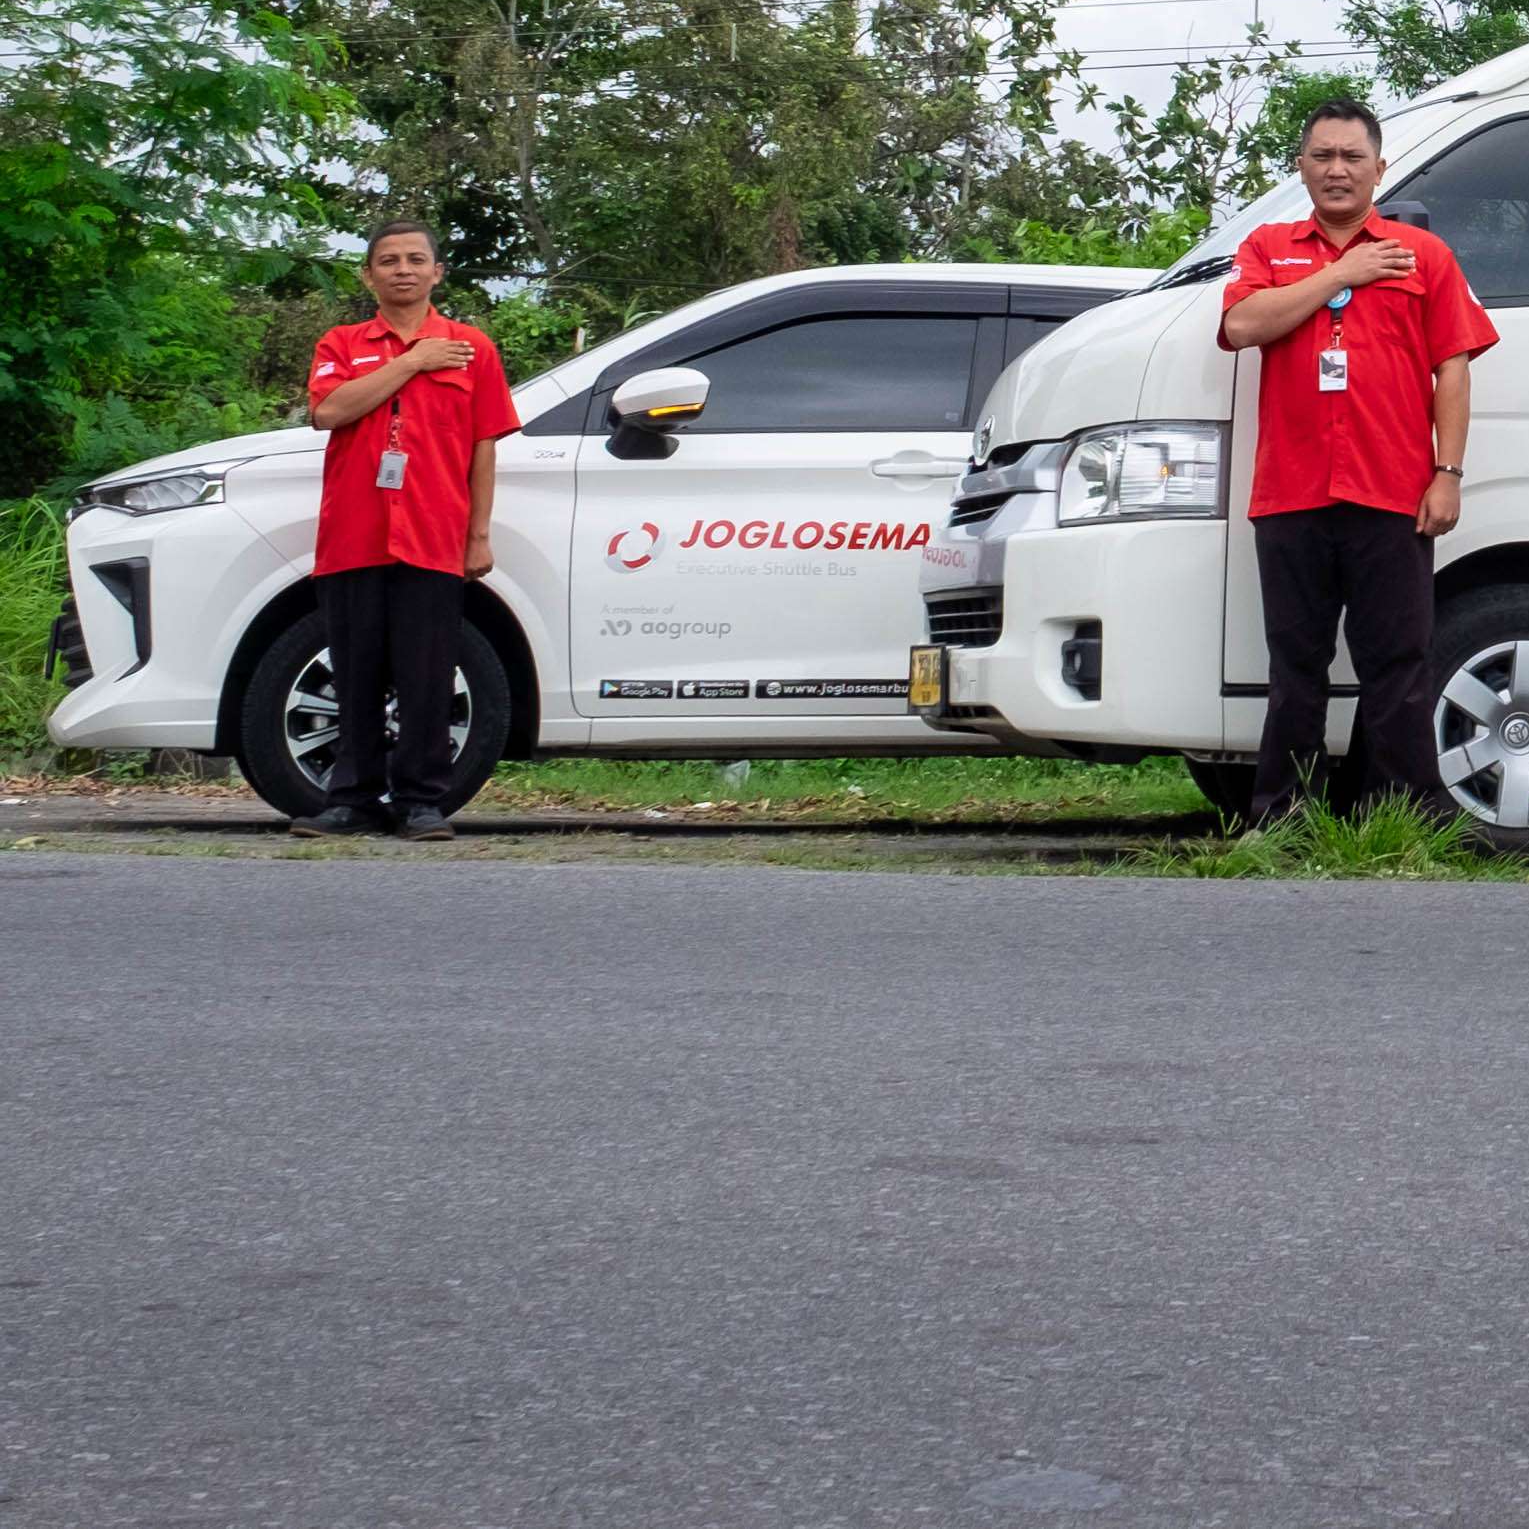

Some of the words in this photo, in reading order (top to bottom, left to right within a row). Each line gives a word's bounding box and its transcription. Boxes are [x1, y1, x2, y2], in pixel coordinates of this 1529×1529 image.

[762, 560, 823, 576] Shuttle
[827, 561, 857, 577] Bus
[640, 621, 732, 639] aogroup
